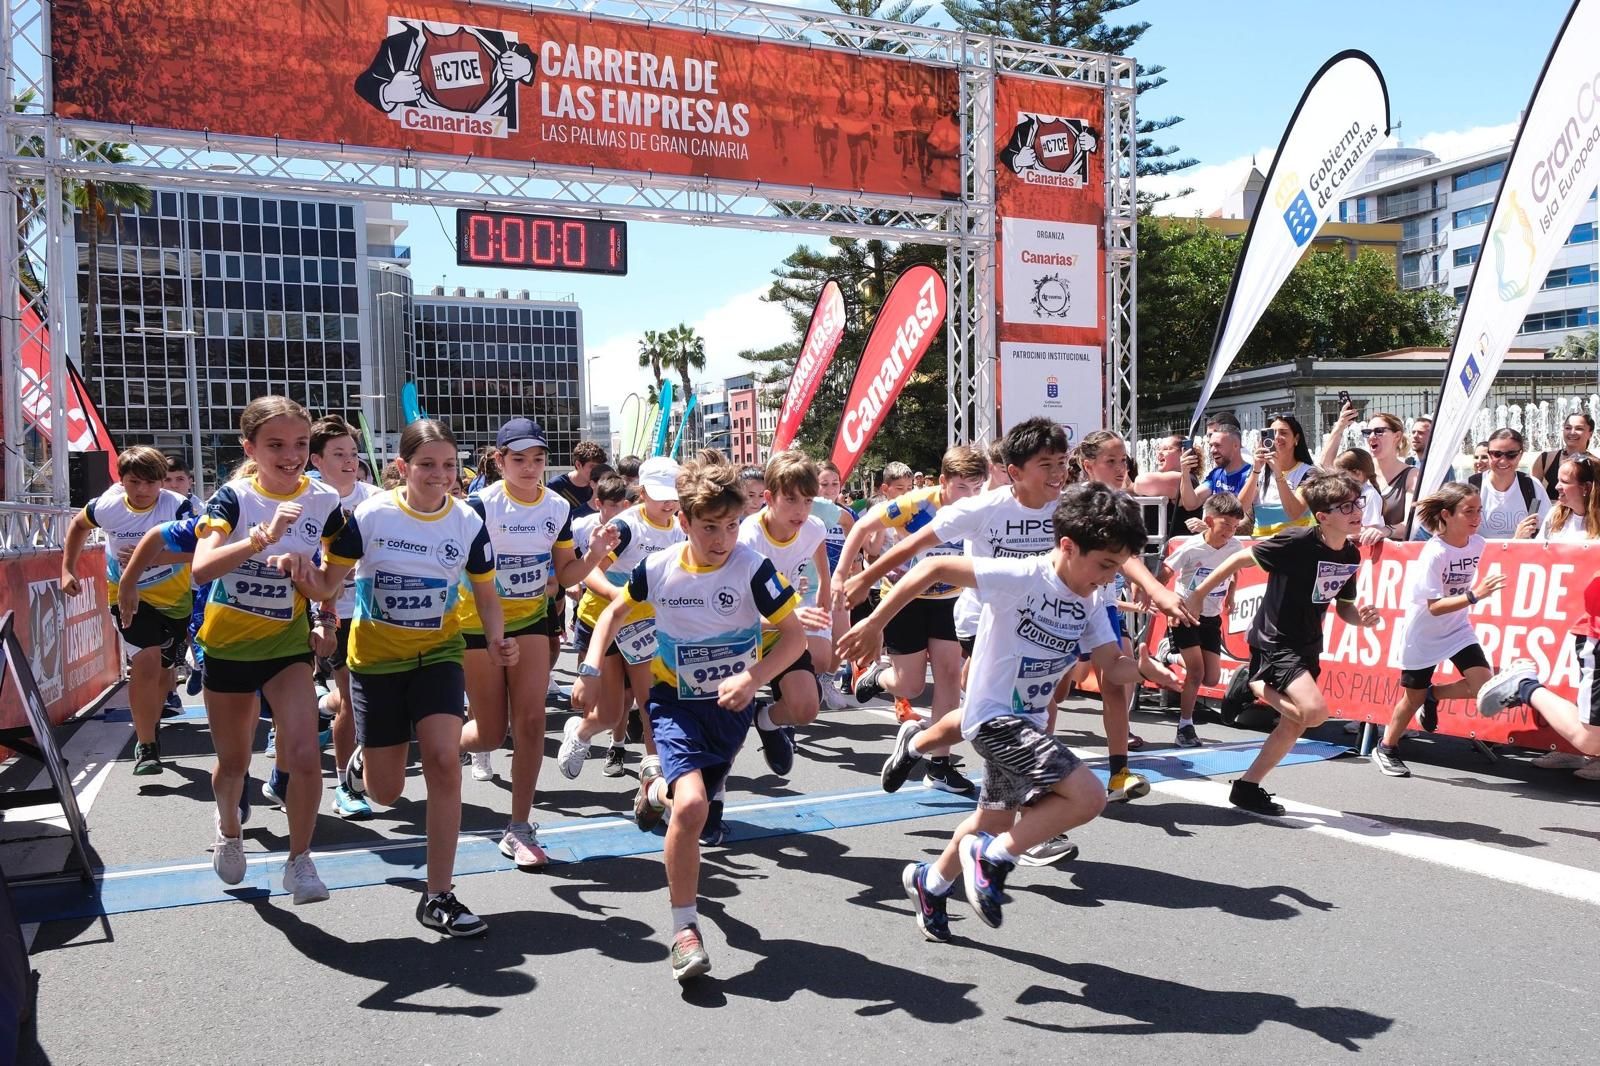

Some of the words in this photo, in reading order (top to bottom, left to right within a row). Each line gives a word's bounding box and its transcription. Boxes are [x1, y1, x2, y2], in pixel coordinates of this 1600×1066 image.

[435, 59, 481, 82] #C7CE
[541, 41, 678, 90] CARRERA
[684, 58, 718, 94] DE
[541, 82, 595, 121] LAS
[602, 88, 750, 137] EMPRESAS
[405, 109, 502, 136] Canarias7
[542, 123, 568, 143] LAS
[571, 126, 626, 148] PALMAS
[630, 132, 646, 151] DE
[650, 134, 688, 155] GRAN
[691, 138, 749, 160] CANARIA
[1042, 138, 1068, 153] #C7CE
[1310, 121, 1360, 192] Gobierno
[1531, 116, 1580, 203] Gran
[1318, 186, 1333, 209] de
[1330, 124, 1378, 188] Canarias
[1026, 171, 1078, 187] Canarias7
[1538, 201, 1560, 234] Isla
[1558, 125, 1600, 201] Europea
[1036, 230, 1065, 240] ORGANIZA
[1022, 250, 1078, 267] Canarias7
[1012, 350, 1046, 360] PATROCINIO
[1047, 352, 1090, 361] INSTITUCIONAL
[842, 275, 940, 453] Canarias7
[306, 522, 317, 535] 90
[546, 521, 556, 532] 90
[388, 540, 427, 553] cofarca
[444, 544, 459, 558] 90
[499, 556, 522, 564] HPS
[377, 576, 402, 584] HPS
[510, 569, 541, 585] 9153
[236, 581, 287, 598] 9222
[1512, 563, 1575, 620] DE
[385, 595, 432, 609] 9224
[668, 597, 704, 606] cofarca
[719, 592, 734, 605] 90
[1022, 625, 1064, 649] JUNIOR
[1319, 612, 1385, 667] LAS
[680, 648, 709, 658] HPS
[1024, 661, 1051, 671] HPS
[1322, 671, 1347, 699] AS
